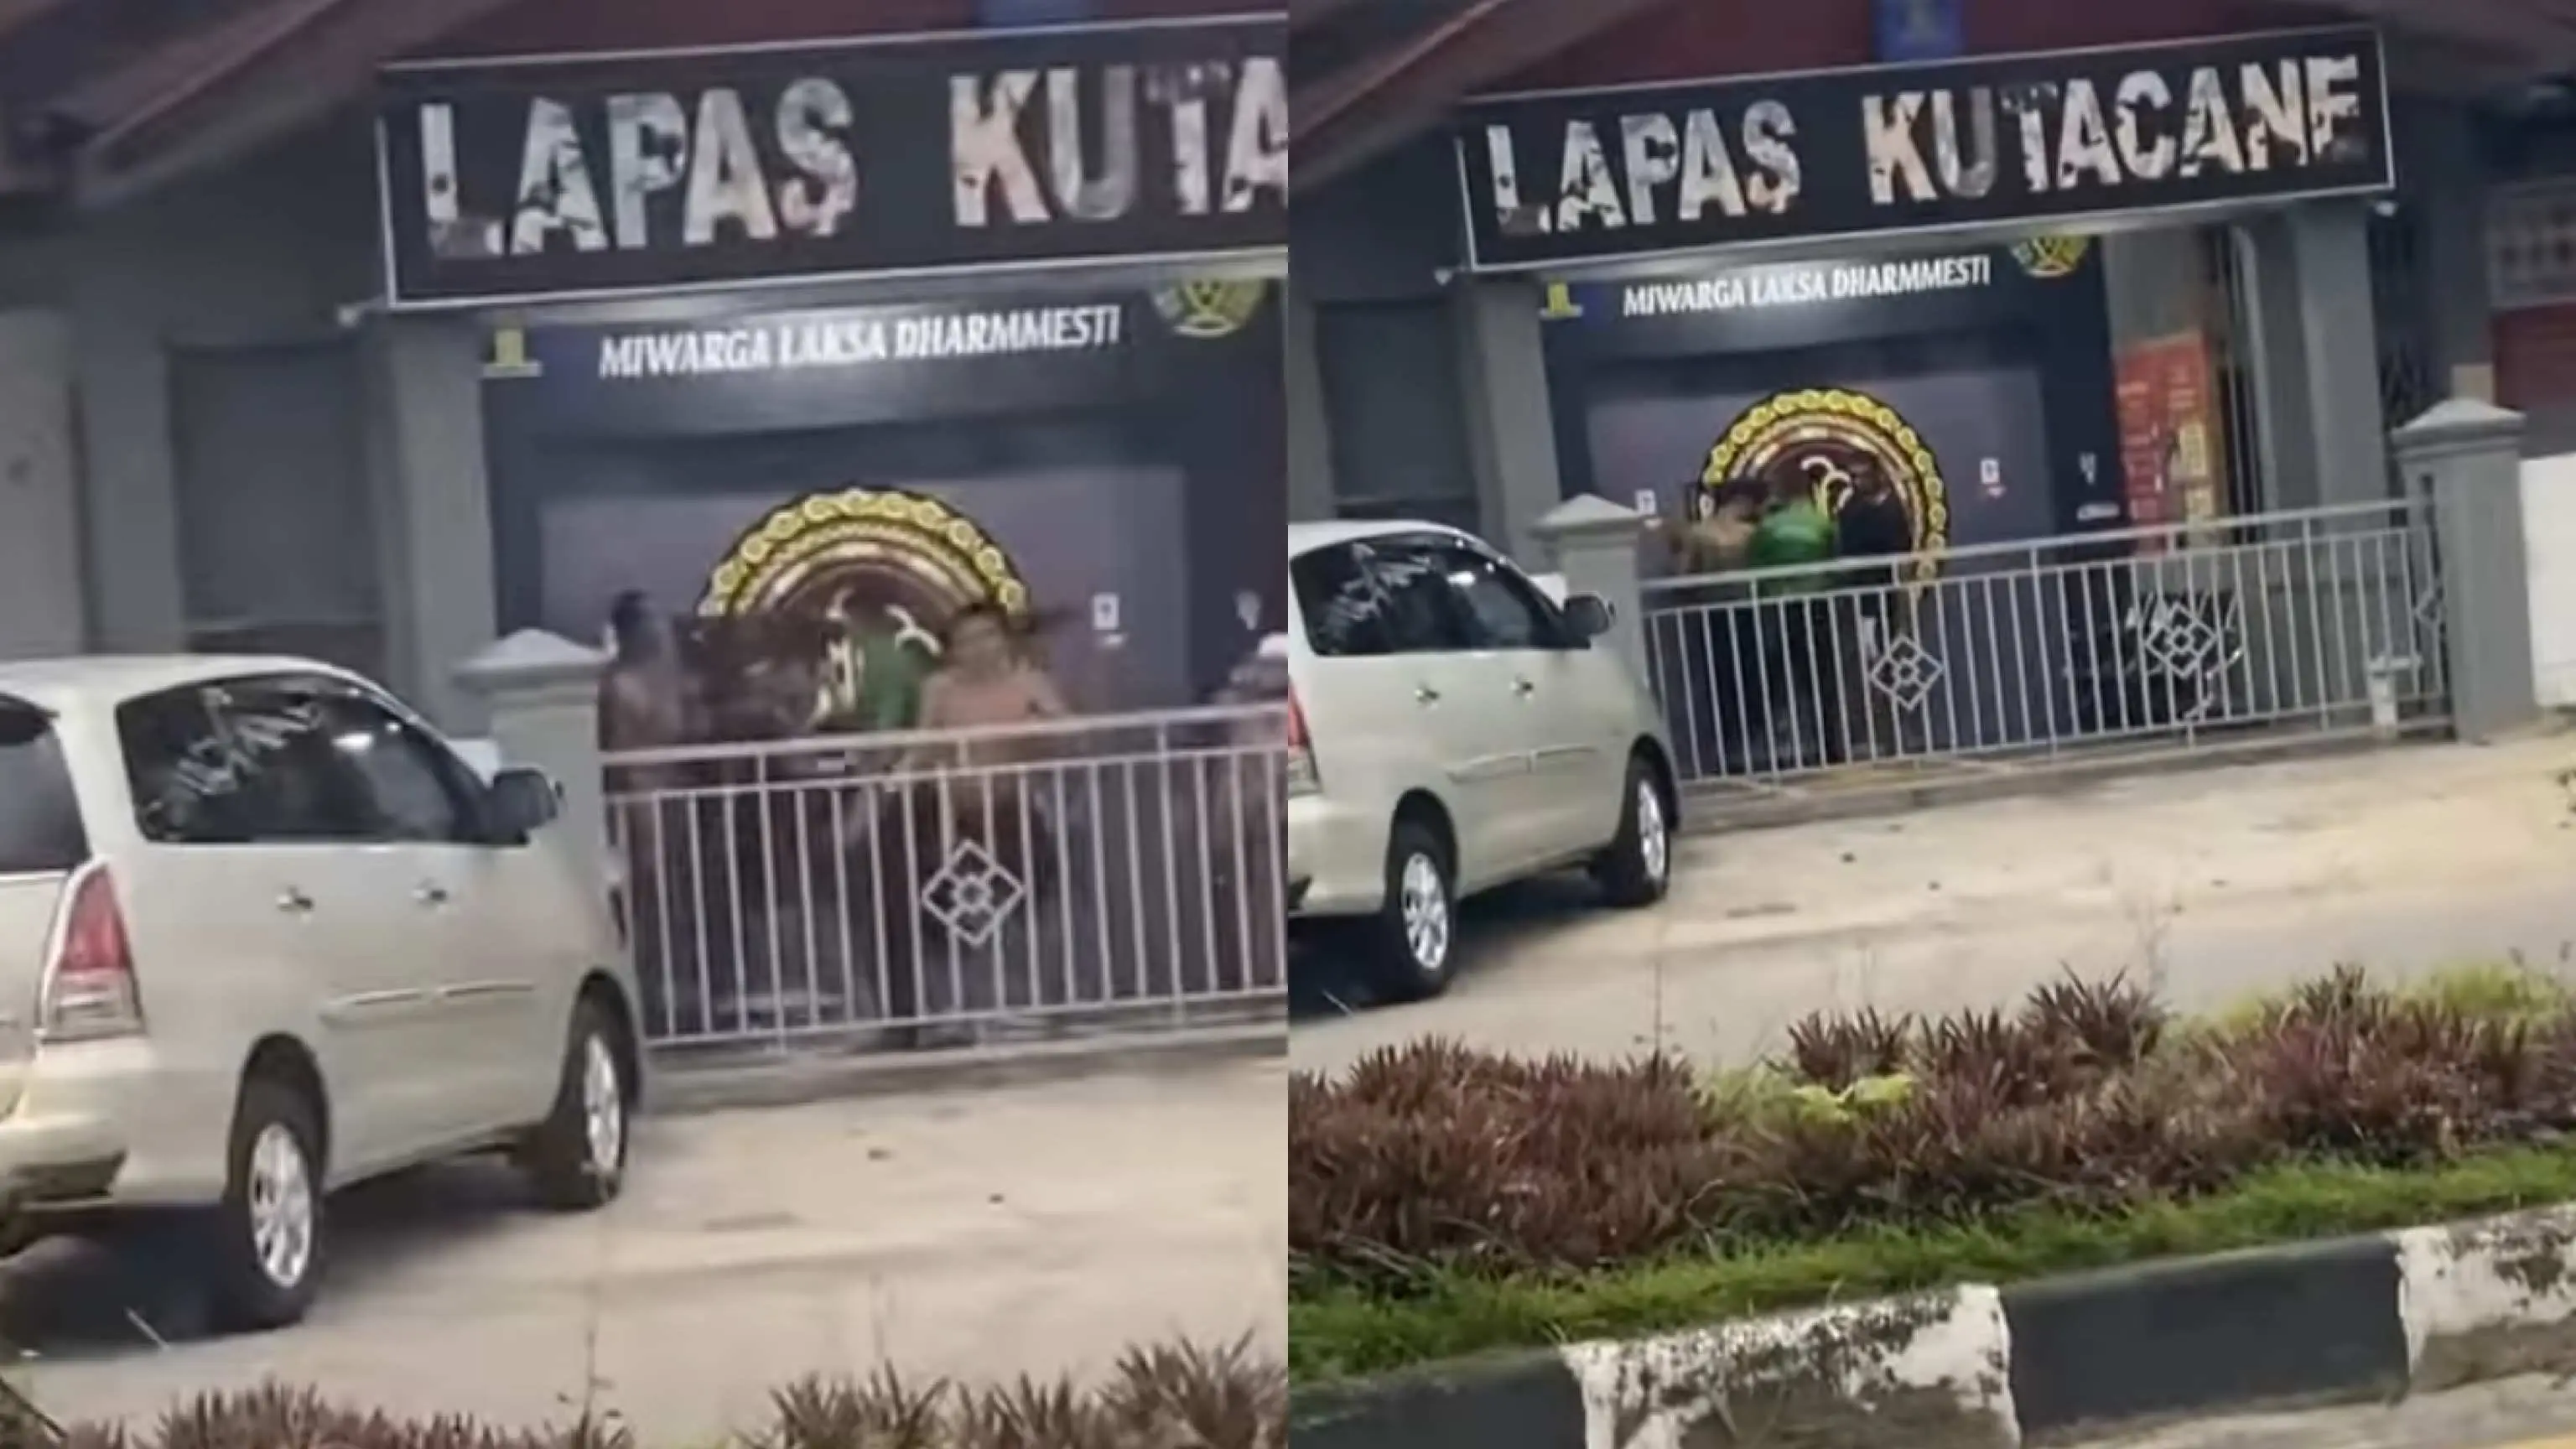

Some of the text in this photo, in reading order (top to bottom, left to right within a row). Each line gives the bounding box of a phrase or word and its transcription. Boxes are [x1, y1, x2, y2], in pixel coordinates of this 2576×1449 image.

[421, 77, 858, 260] LAPAS
[1486, 98, 1800, 236] LAPAS
[778, 319, 886, 366] LAKSA
[894, 304, 1121, 357] DHARMMESTI
[1623, 254, 1992, 317] MIWARGA LAKSA DHARMMESTI
